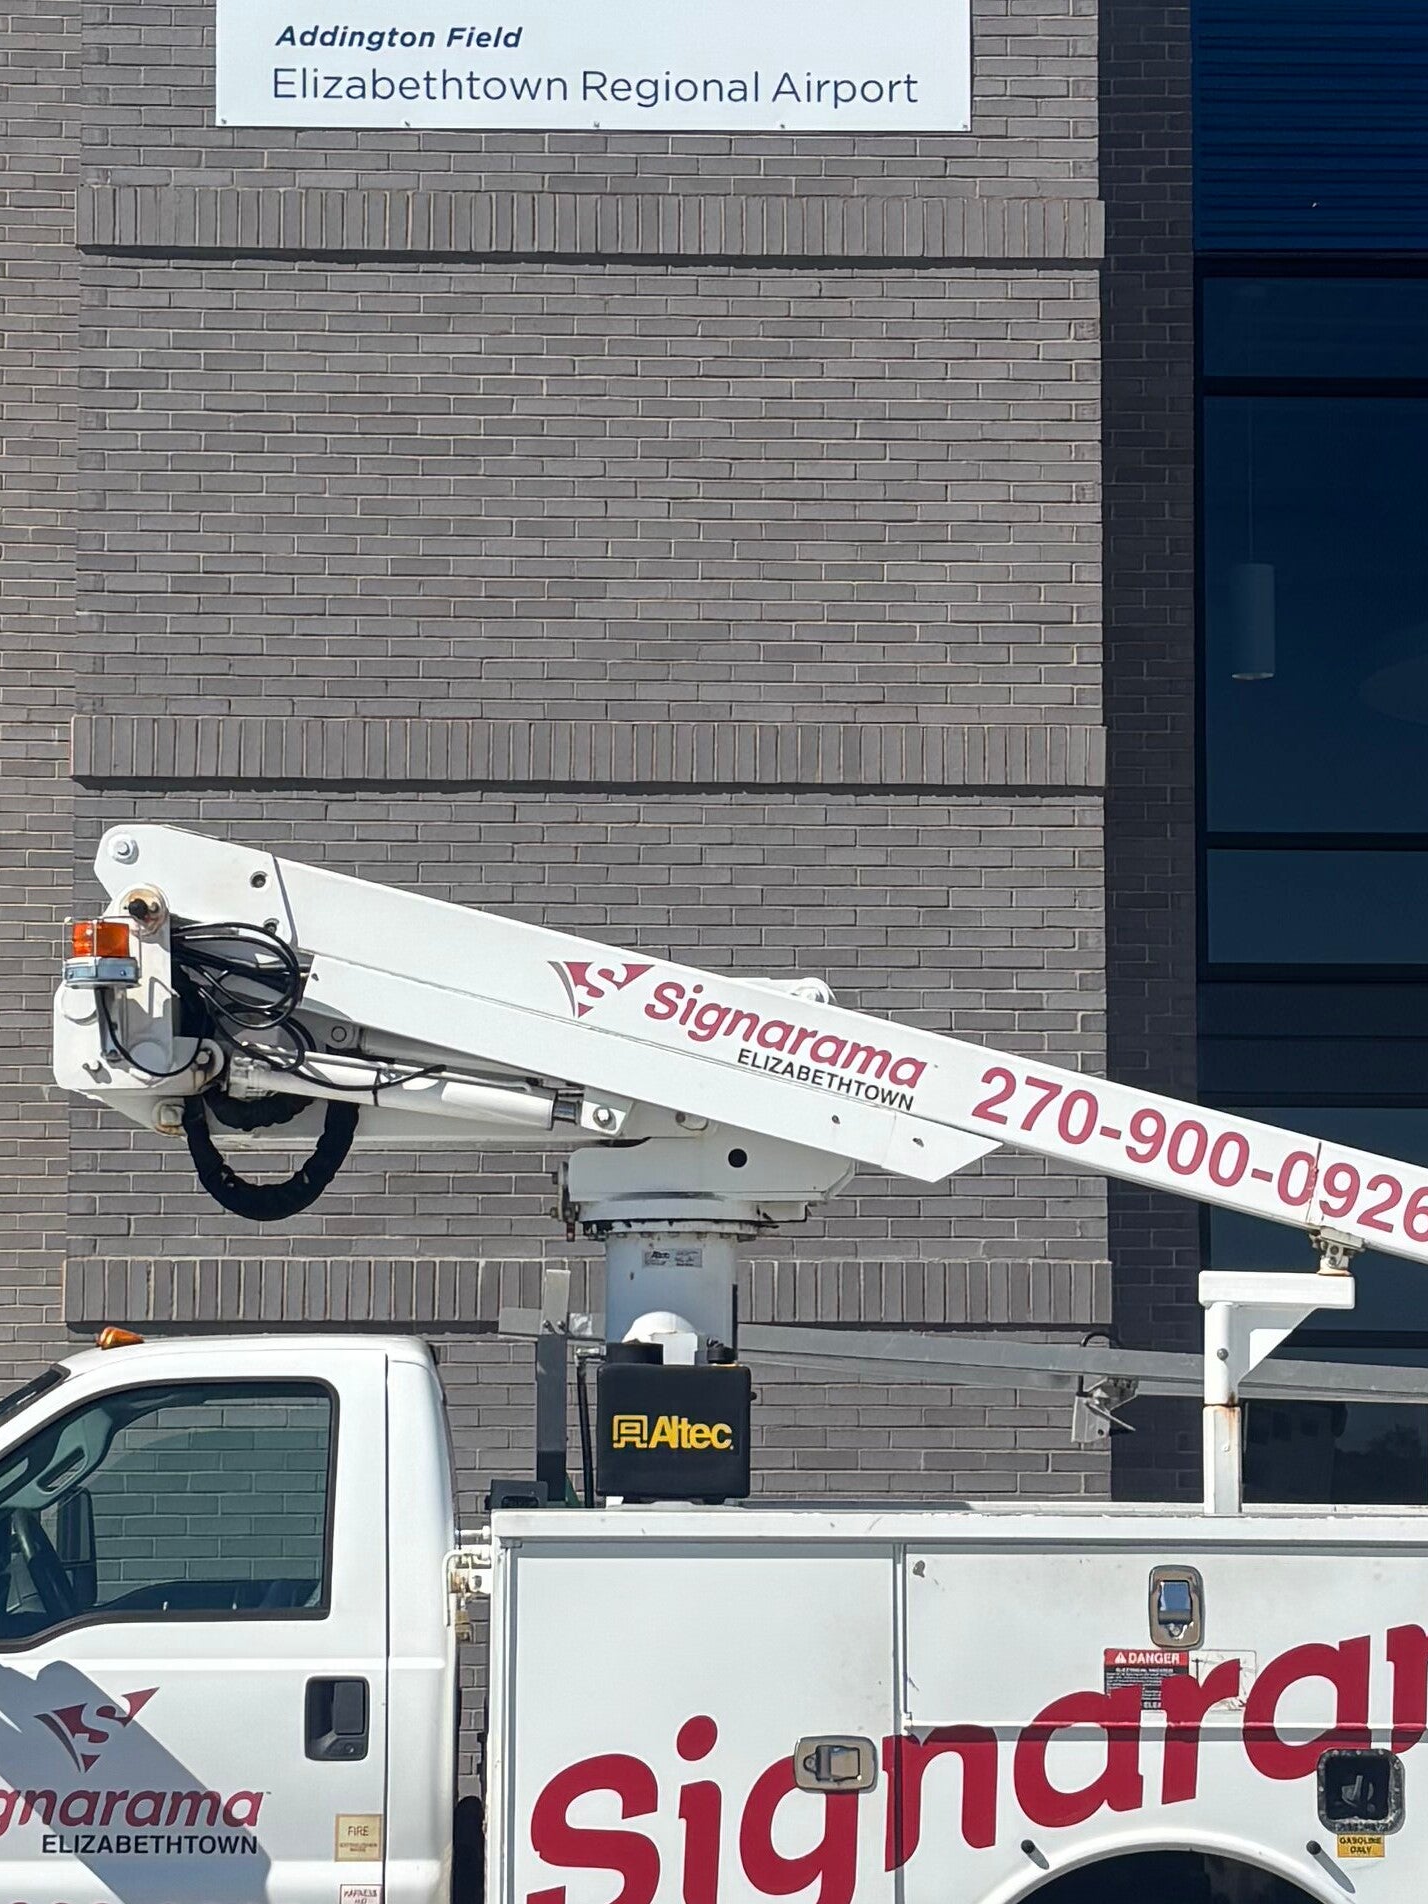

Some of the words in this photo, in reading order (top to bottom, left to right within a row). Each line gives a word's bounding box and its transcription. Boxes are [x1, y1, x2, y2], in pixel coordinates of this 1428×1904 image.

[275, 24, 436, 51] Addington
[446, 25, 523, 49] Field
[273, 68, 568, 100] Elizabethtown
[582, 71, 759, 108] Regional
[771, 73, 919, 110] Airport
[643, 981, 928, 1089] Signarama
[737, 1048, 914, 1112] ELIZABETHTOWN
[648, 1415, 734, 1450] Altec
[1127, 1651, 1180, 1665] DANGER
[42, 1834, 258, 1855] ELIZABETHTOWN
[347, 1825, 369, 1836] FIRE
